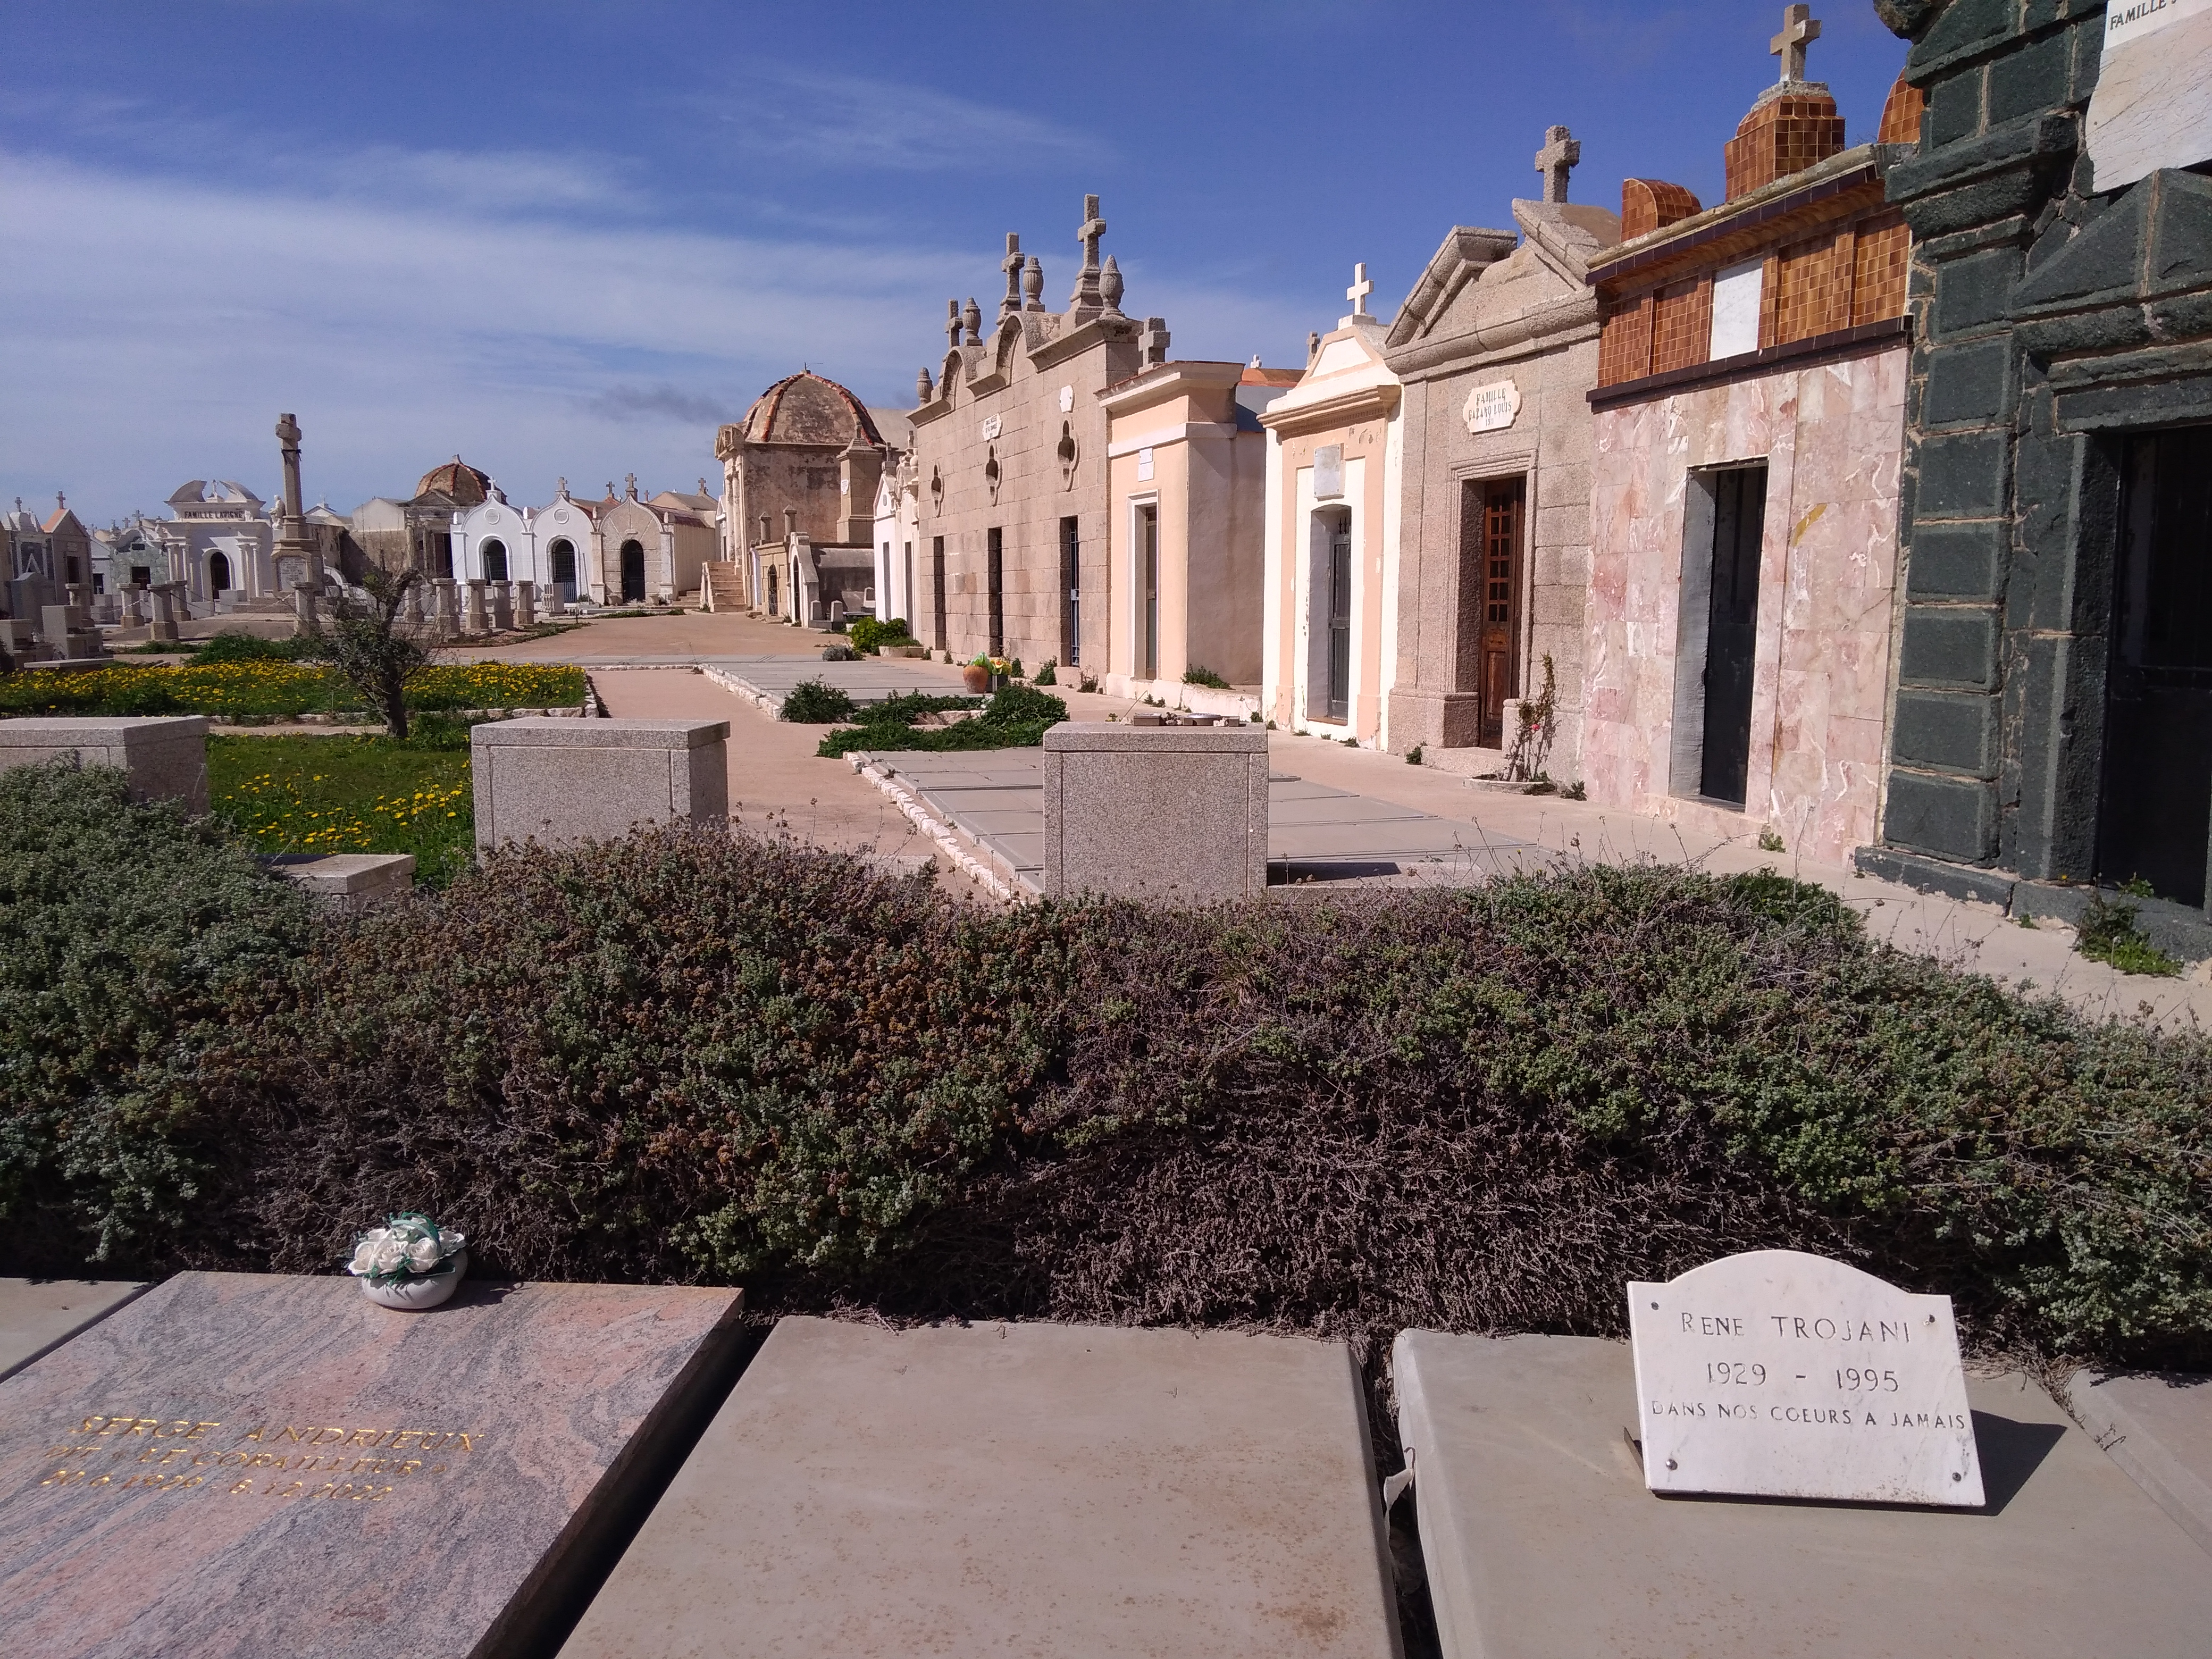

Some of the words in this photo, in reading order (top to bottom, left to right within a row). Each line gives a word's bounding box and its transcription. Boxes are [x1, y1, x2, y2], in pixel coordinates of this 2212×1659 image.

[2109, 0, 2167, 30] FAMILLE
[1476, 388, 1506, 405] FAMILLE
[1494, 401, 1512, 415] LOUIS
[1681, 1312, 1744, 1337] RENE
[1771, 1316, 1910, 1343] TROJANI
[1707, 1362, 1767, 1386] 1929
[1836, 1368, 1899, 1393] 1995
[1652, 1401, 1706, 1417] DANS
[1718, 1404, 1758, 1419] NOS
[1771, 1406, 1851, 1425] COEURS
[1865, 1412, 1876, 1426] A
[1891, 1414, 1966, 1430] JAMAIS
[66, 1416, 221, 1439] SERGE
[244, 1426, 484, 1452] ANDRIEUX
[44, 1446, 102, 1458] DIT
[136, 1448, 188, 1463] LE
[191, 1451, 422, 1474] CORAILLEUR
